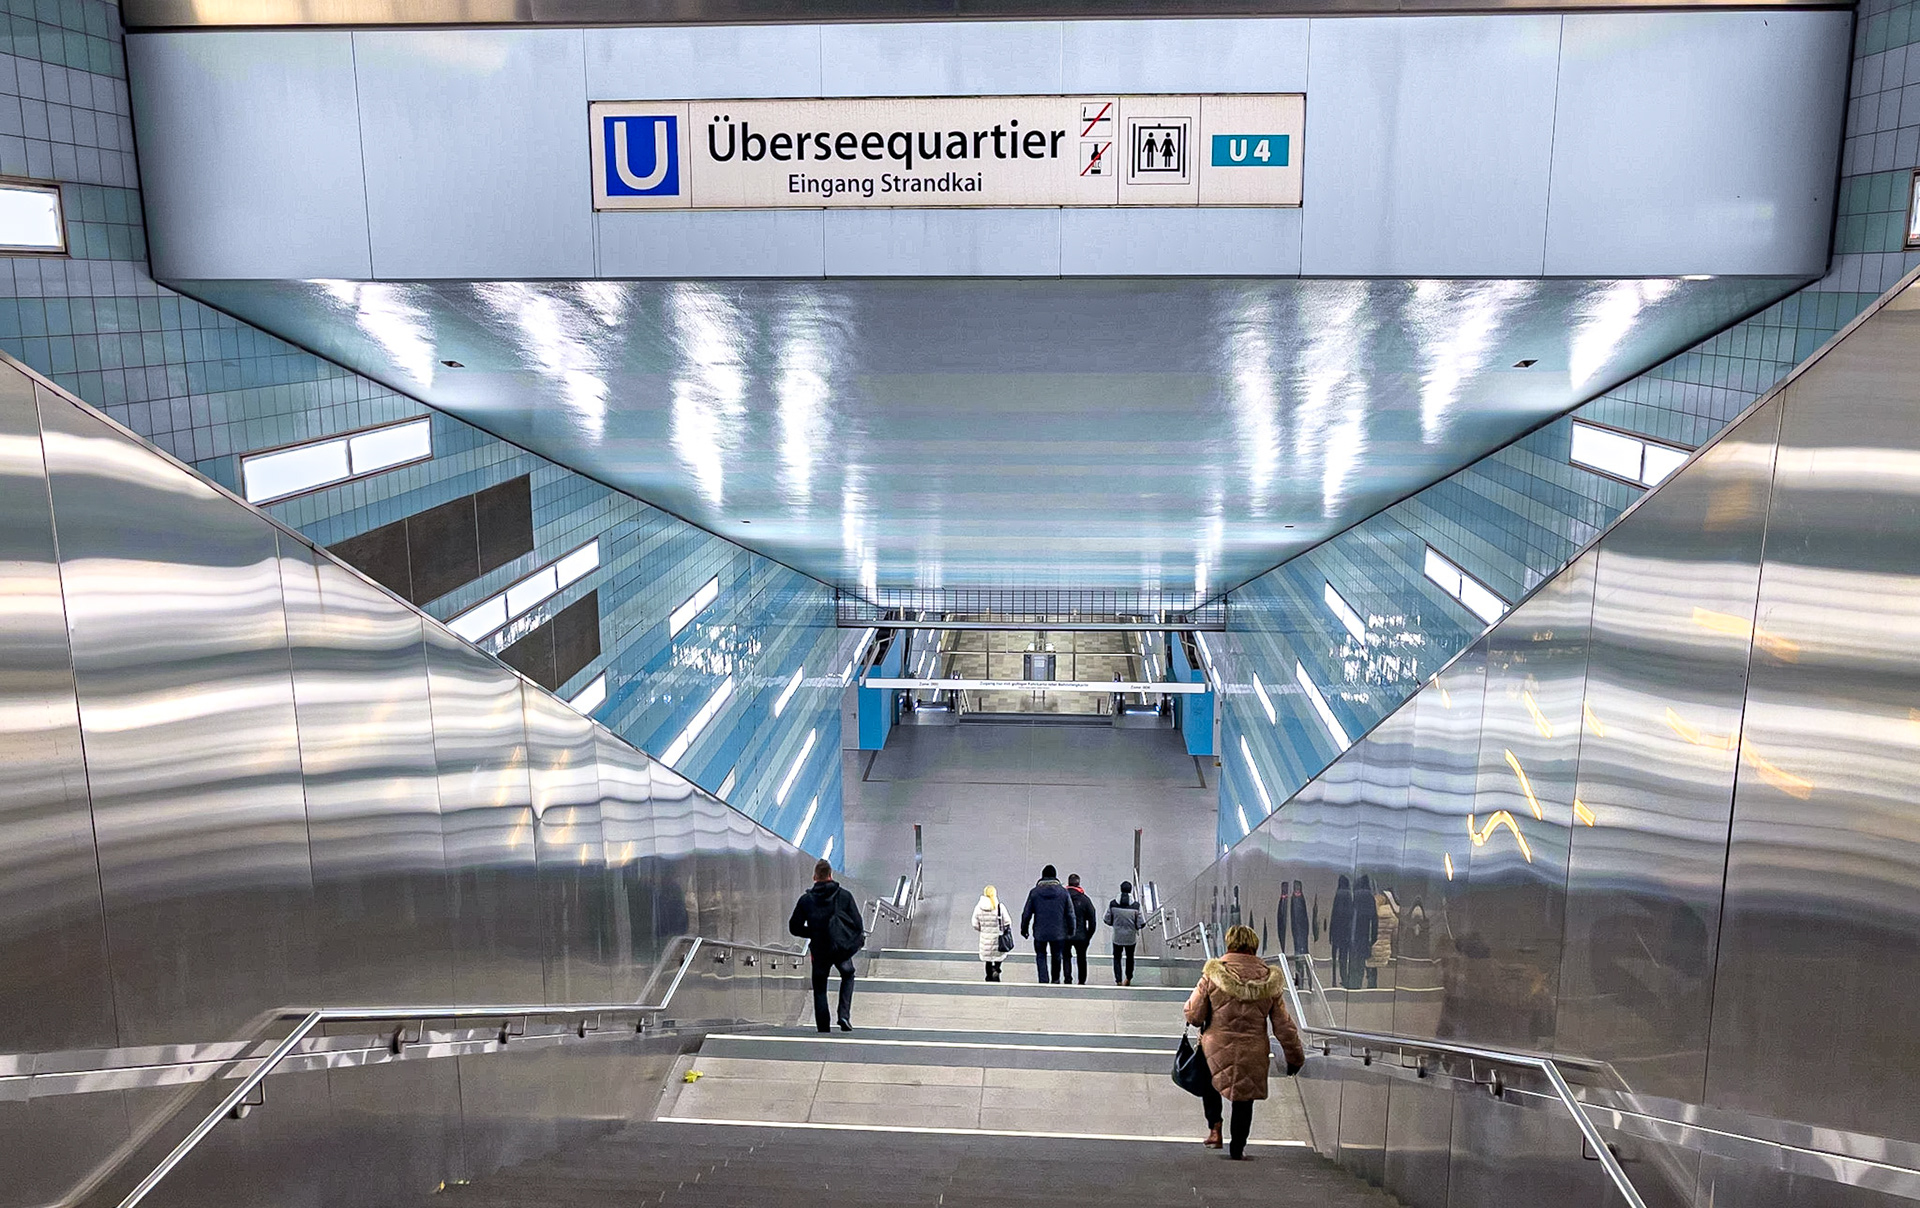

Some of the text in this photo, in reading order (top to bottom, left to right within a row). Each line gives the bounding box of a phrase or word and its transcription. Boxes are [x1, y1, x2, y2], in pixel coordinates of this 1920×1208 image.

[614, 120, 669, 190] U
[708, 114, 1066, 170] Überseequartier
[788, 173, 982, 197] Eingang Strandkai
